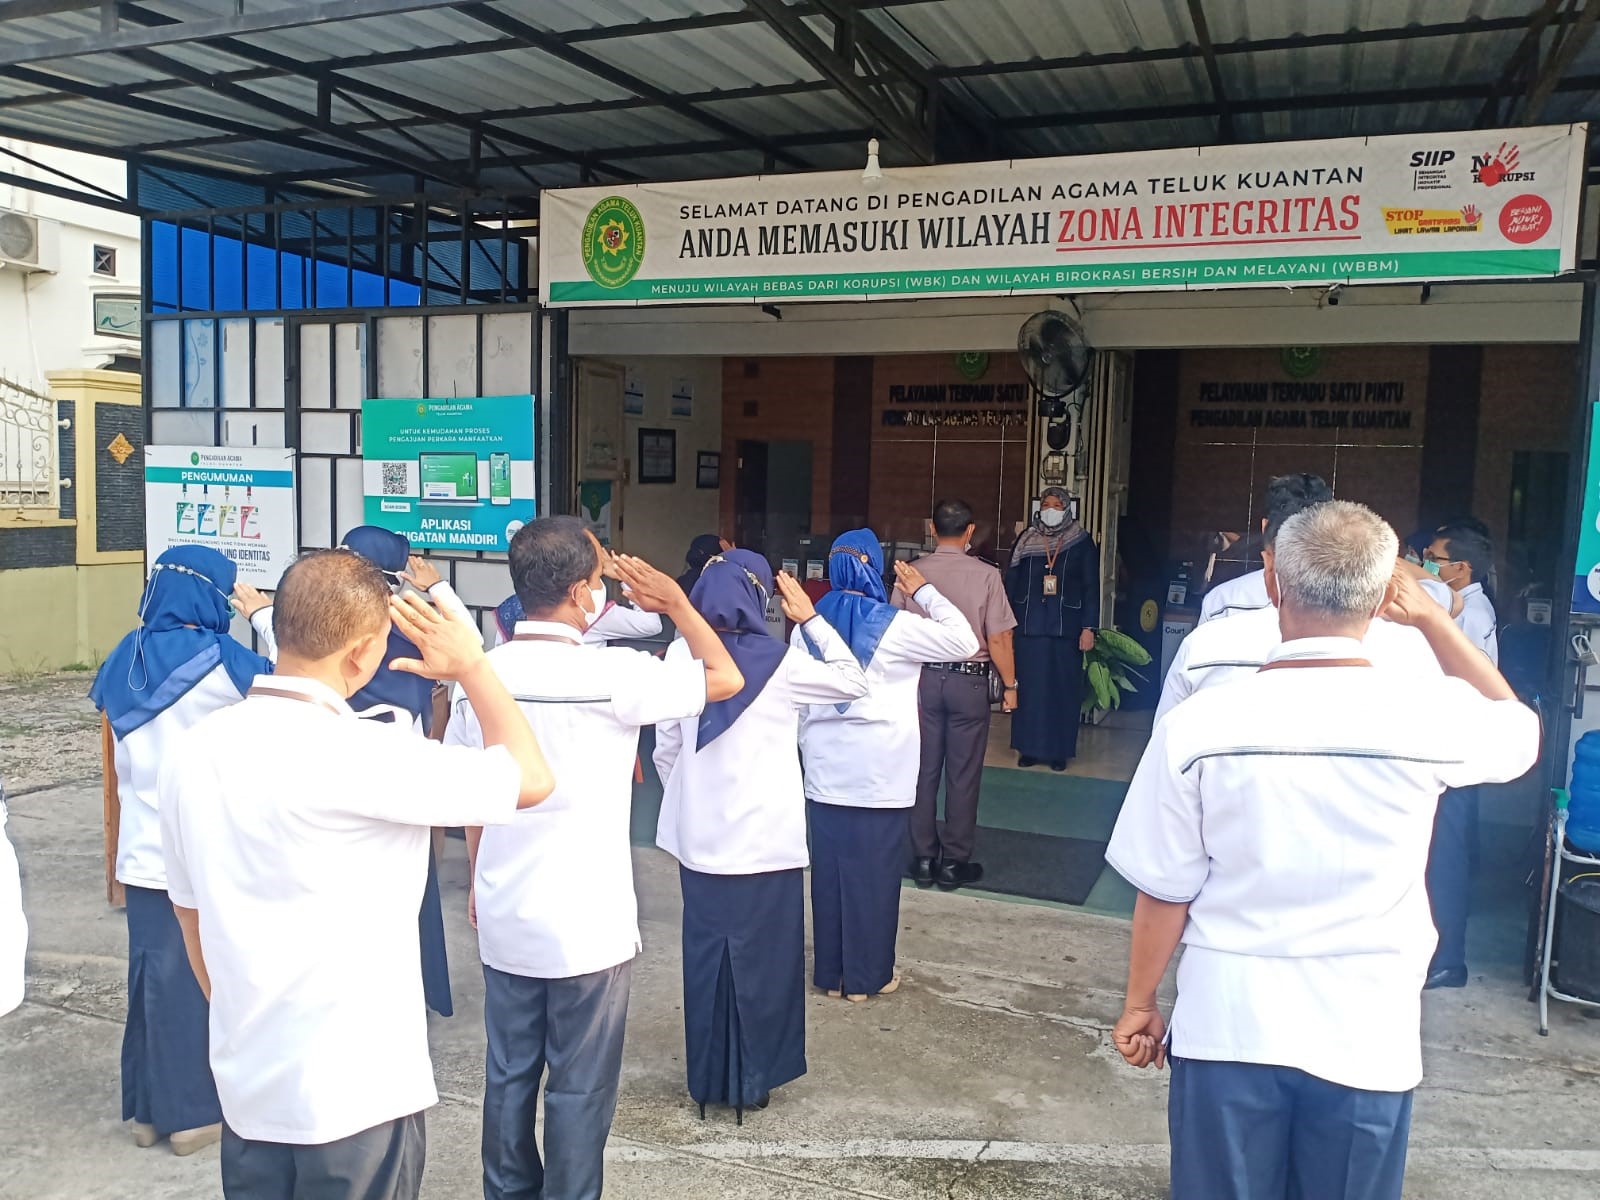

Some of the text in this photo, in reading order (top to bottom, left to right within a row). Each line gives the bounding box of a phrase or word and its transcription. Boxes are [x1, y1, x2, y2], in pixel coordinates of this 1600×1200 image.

[1409, 150, 1455, 167] SIIP
[679, 166, 1363, 220] SELAMAT DATANG DI PENGADILAN AGAMA TELUK KUANTAN
[597, 199, 620, 214] AGAMA
[621, 201, 639, 222] TELUK
[1385, 209, 1424, 222] STOP
[679, 194, 1360, 259] ANDA MEMASUKI WILAYAH ZONA INTEGRITAS
[651, 260, 1399, 294] MENUJU WILAYAH BEBAS DARI KORUPSI (WBK) DAN WILAYAH BIROKRASI BERSIH DAN MELAYANI (WBBM)
[996, 383, 1025, 402] SATU
[1199, 381, 1404, 401] PELAYANAN TERPADU SATU PINTU
[1190, 409, 1411, 427] PENGADILAN AGAMA TELUK KUANTAN
[422, 427, 463, 435] KEMUDAHAN
[181, 471, 254, 483] PENGUMUMAN
[420, 518, 472, 531] APLIKASI
[449, 531, 498, 545] MANDIRI
[238, 549, 271, 561] IDENTITAS
[1165, 626, 1185, 634] Court
